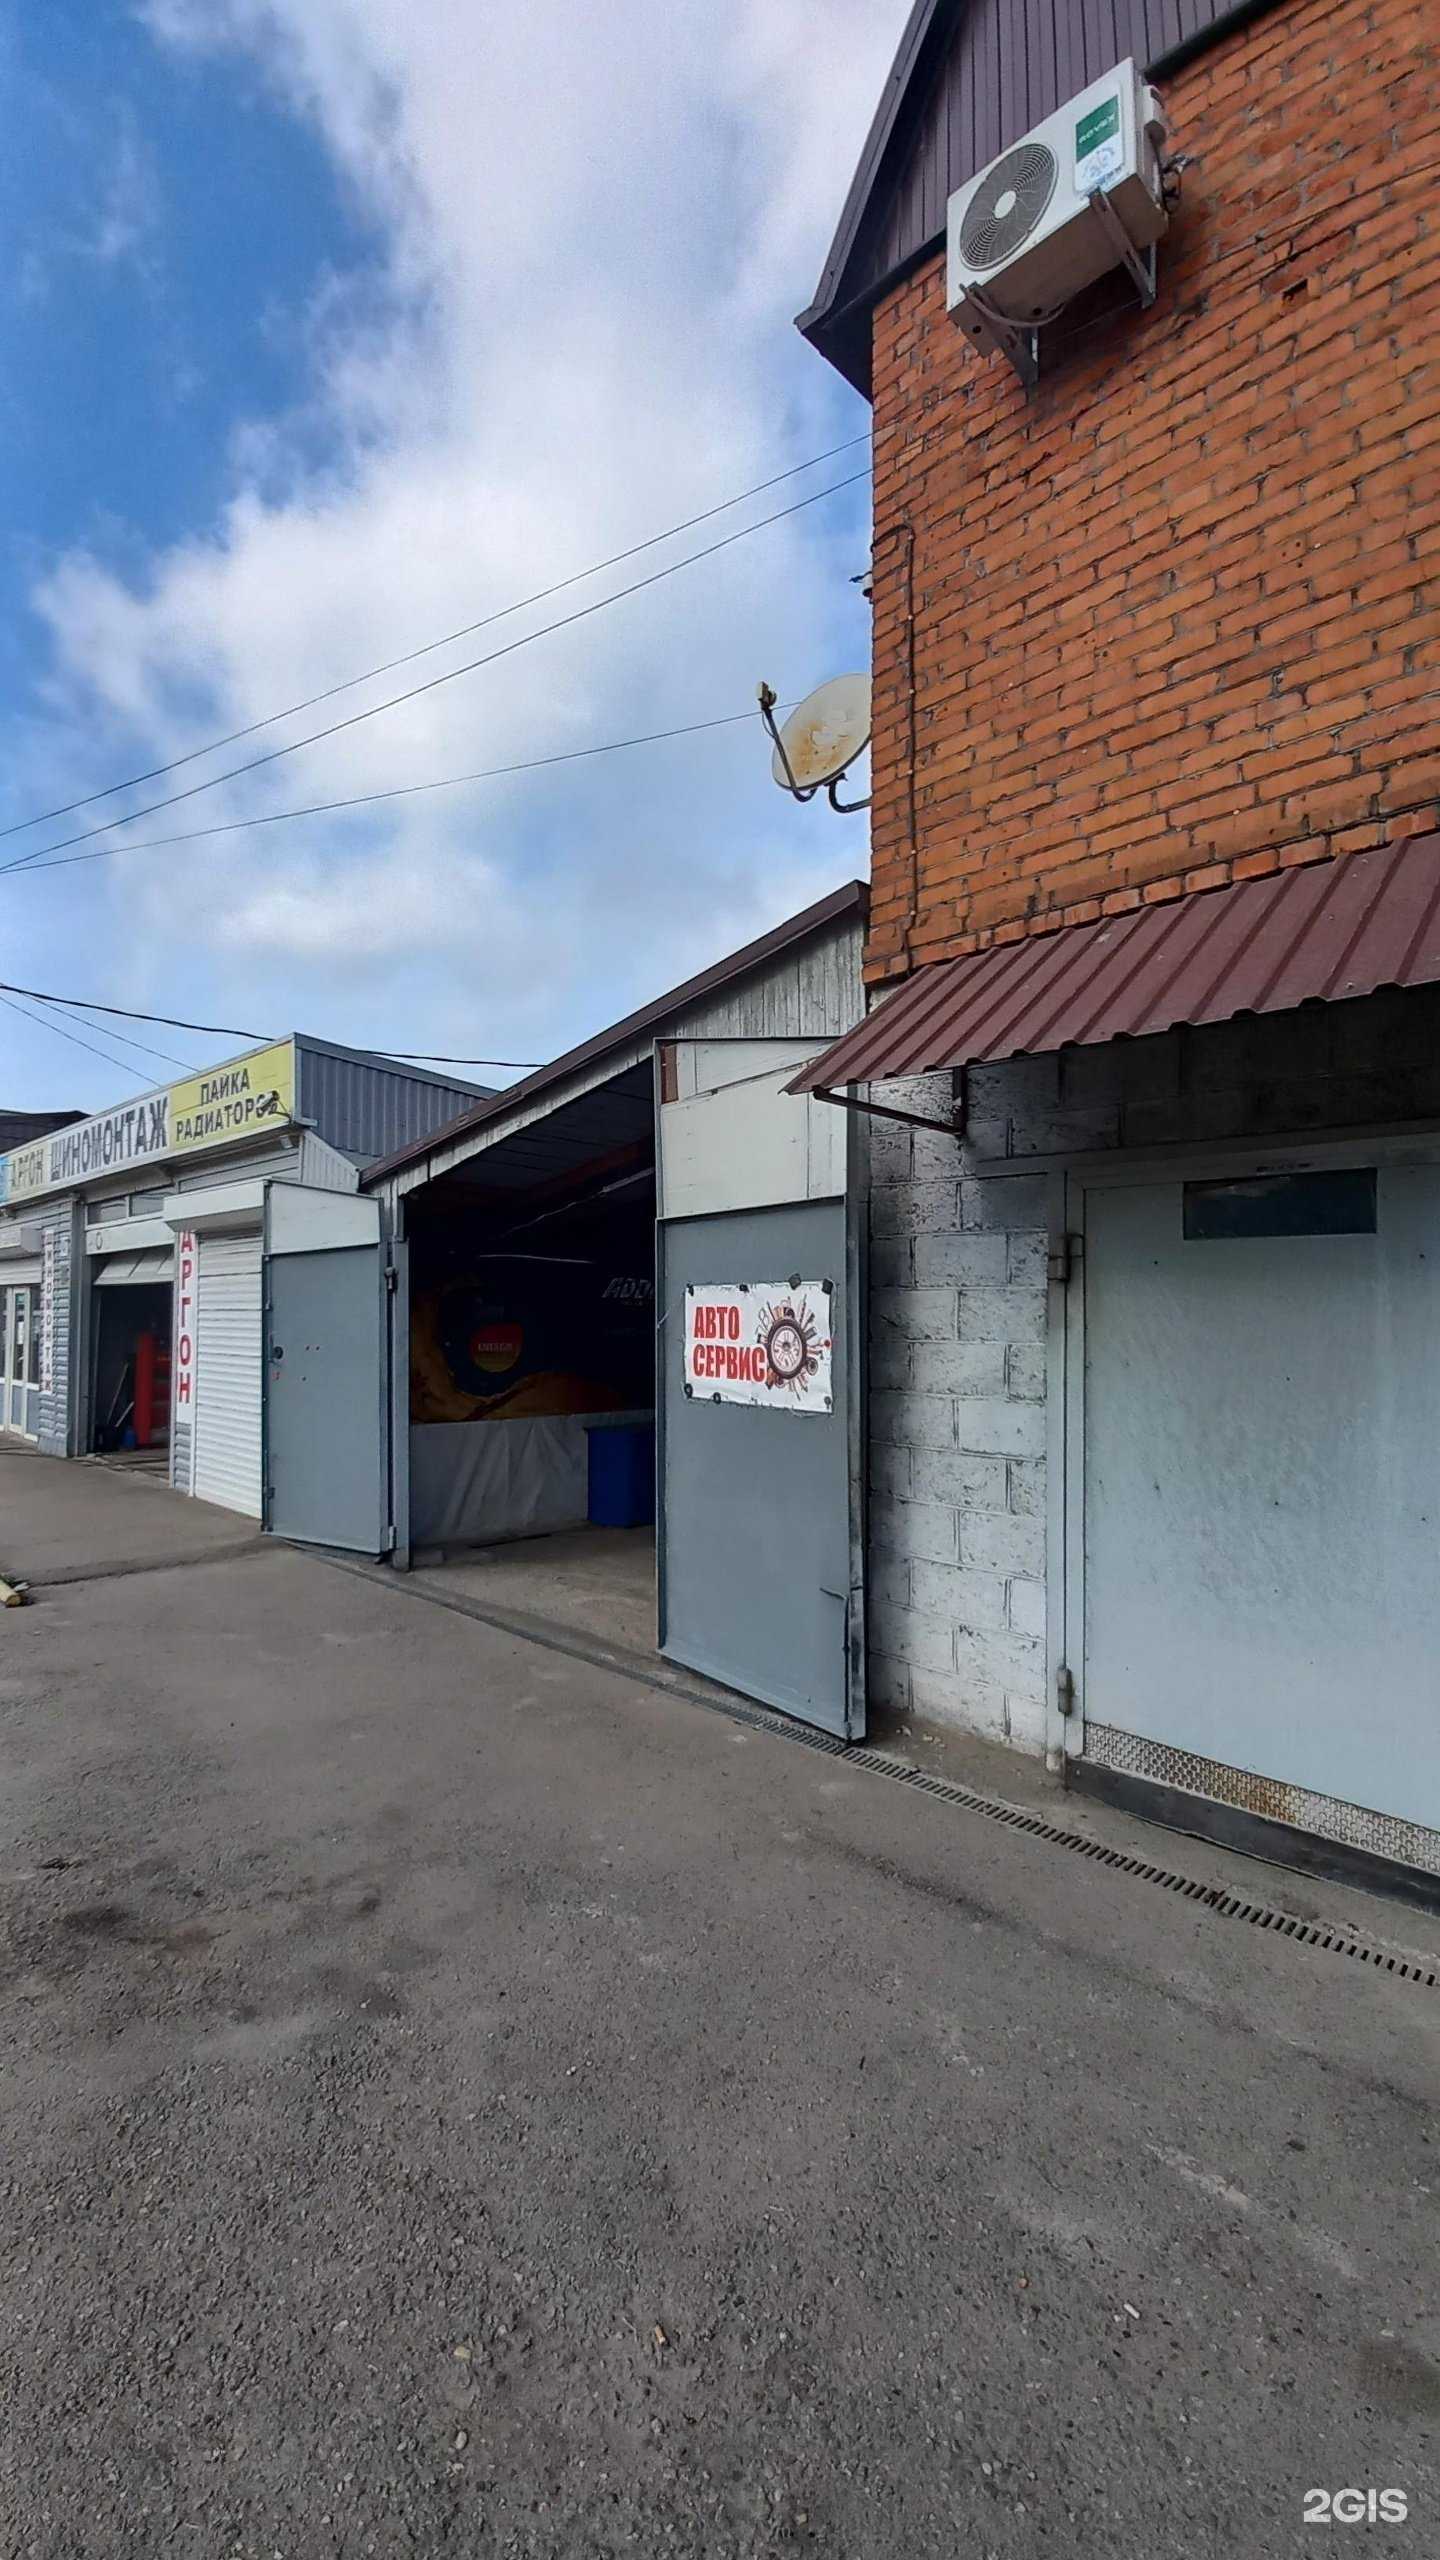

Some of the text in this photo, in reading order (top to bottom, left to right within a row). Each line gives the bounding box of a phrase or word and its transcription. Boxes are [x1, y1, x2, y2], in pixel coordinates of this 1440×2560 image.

[51, 1096, 168, 1181] ШИНОМОНТАЖ
[178, 1231, 193, 1404] АРГОН
[694, 1306, 740, 1340] АВТО
[693, 1344, 765, 1382] СЕРВИС
